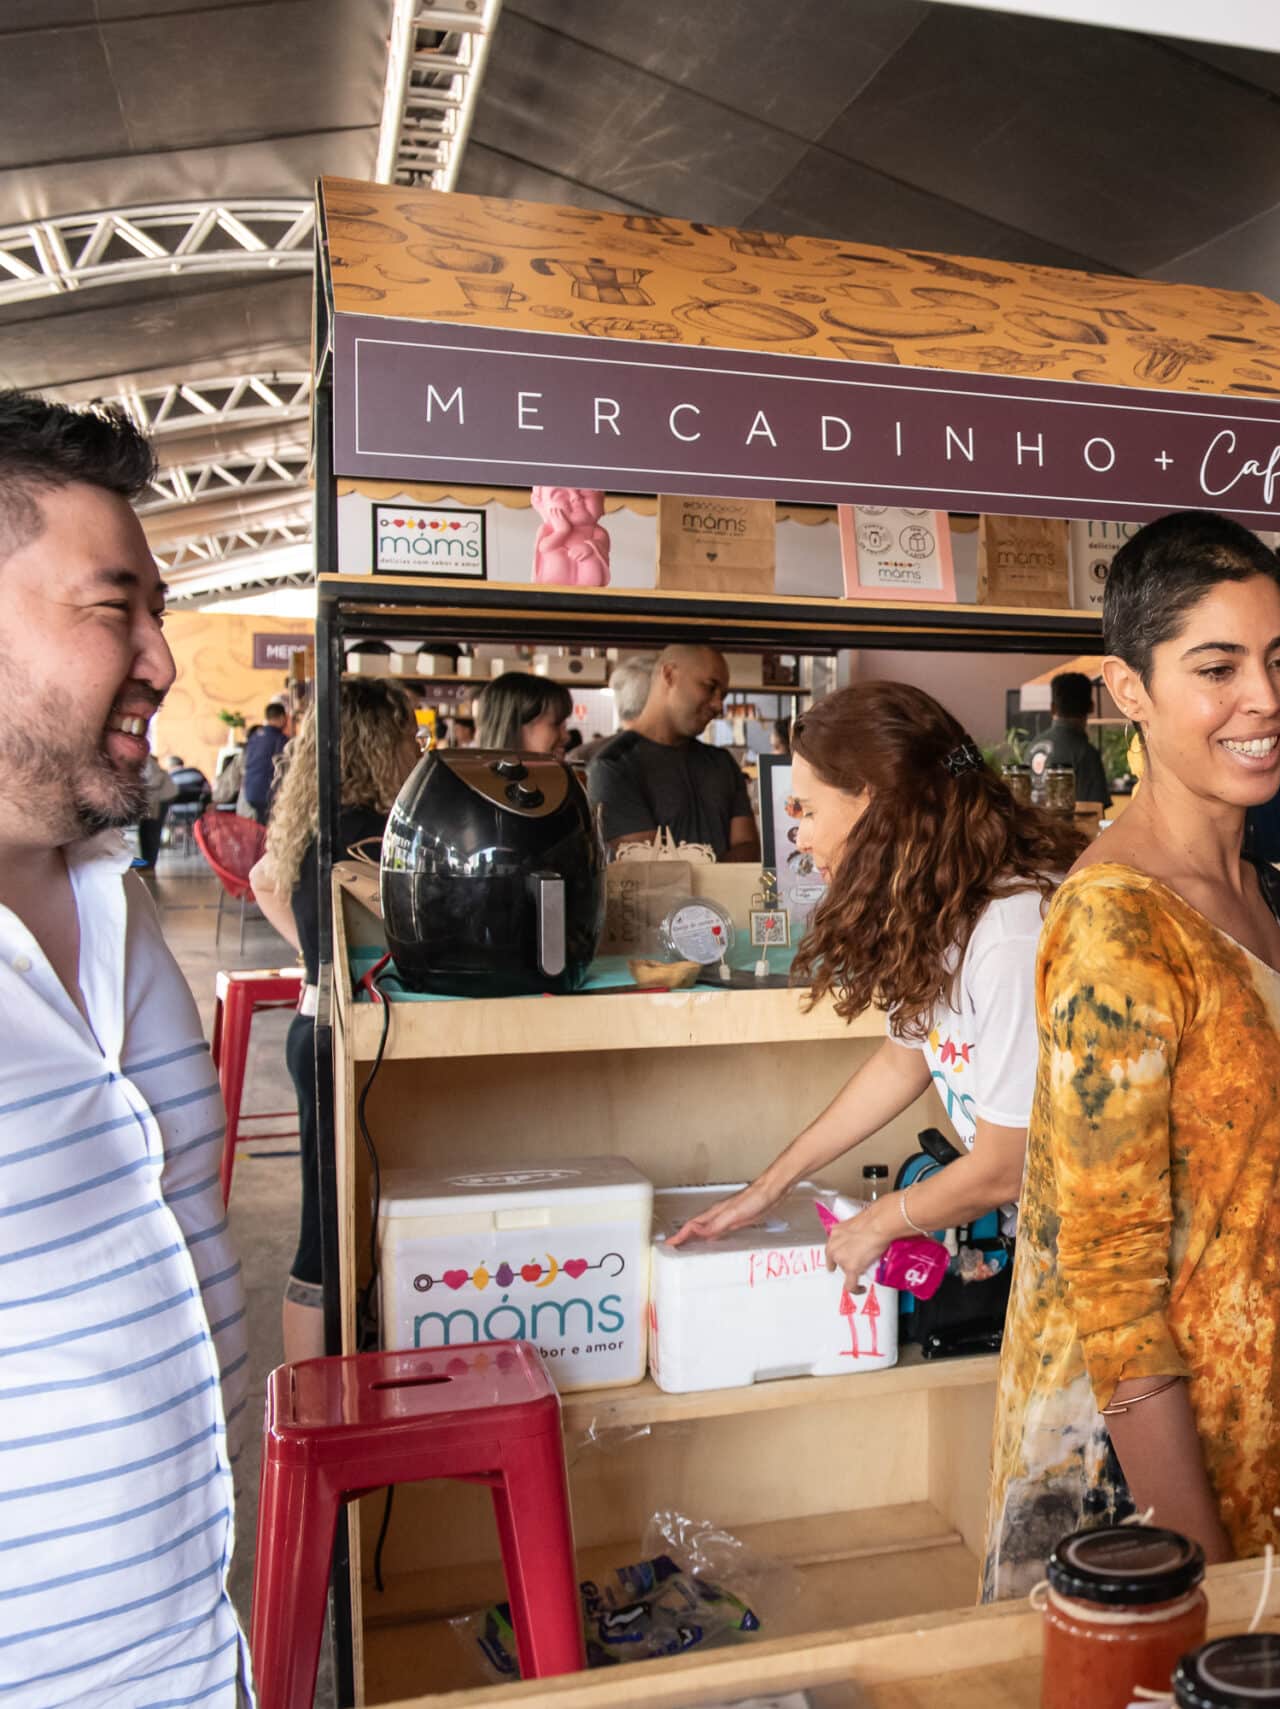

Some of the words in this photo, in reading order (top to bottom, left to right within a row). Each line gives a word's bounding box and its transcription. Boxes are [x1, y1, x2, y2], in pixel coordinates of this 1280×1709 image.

[425, 383, 1116, 473] MERCADINHO
[380, 532, 480, 558] máms
[414, 1294, 625, 1348] máms
[571, 1347, 580, 1355] e
[585, 1341, 625, 1353] amor
